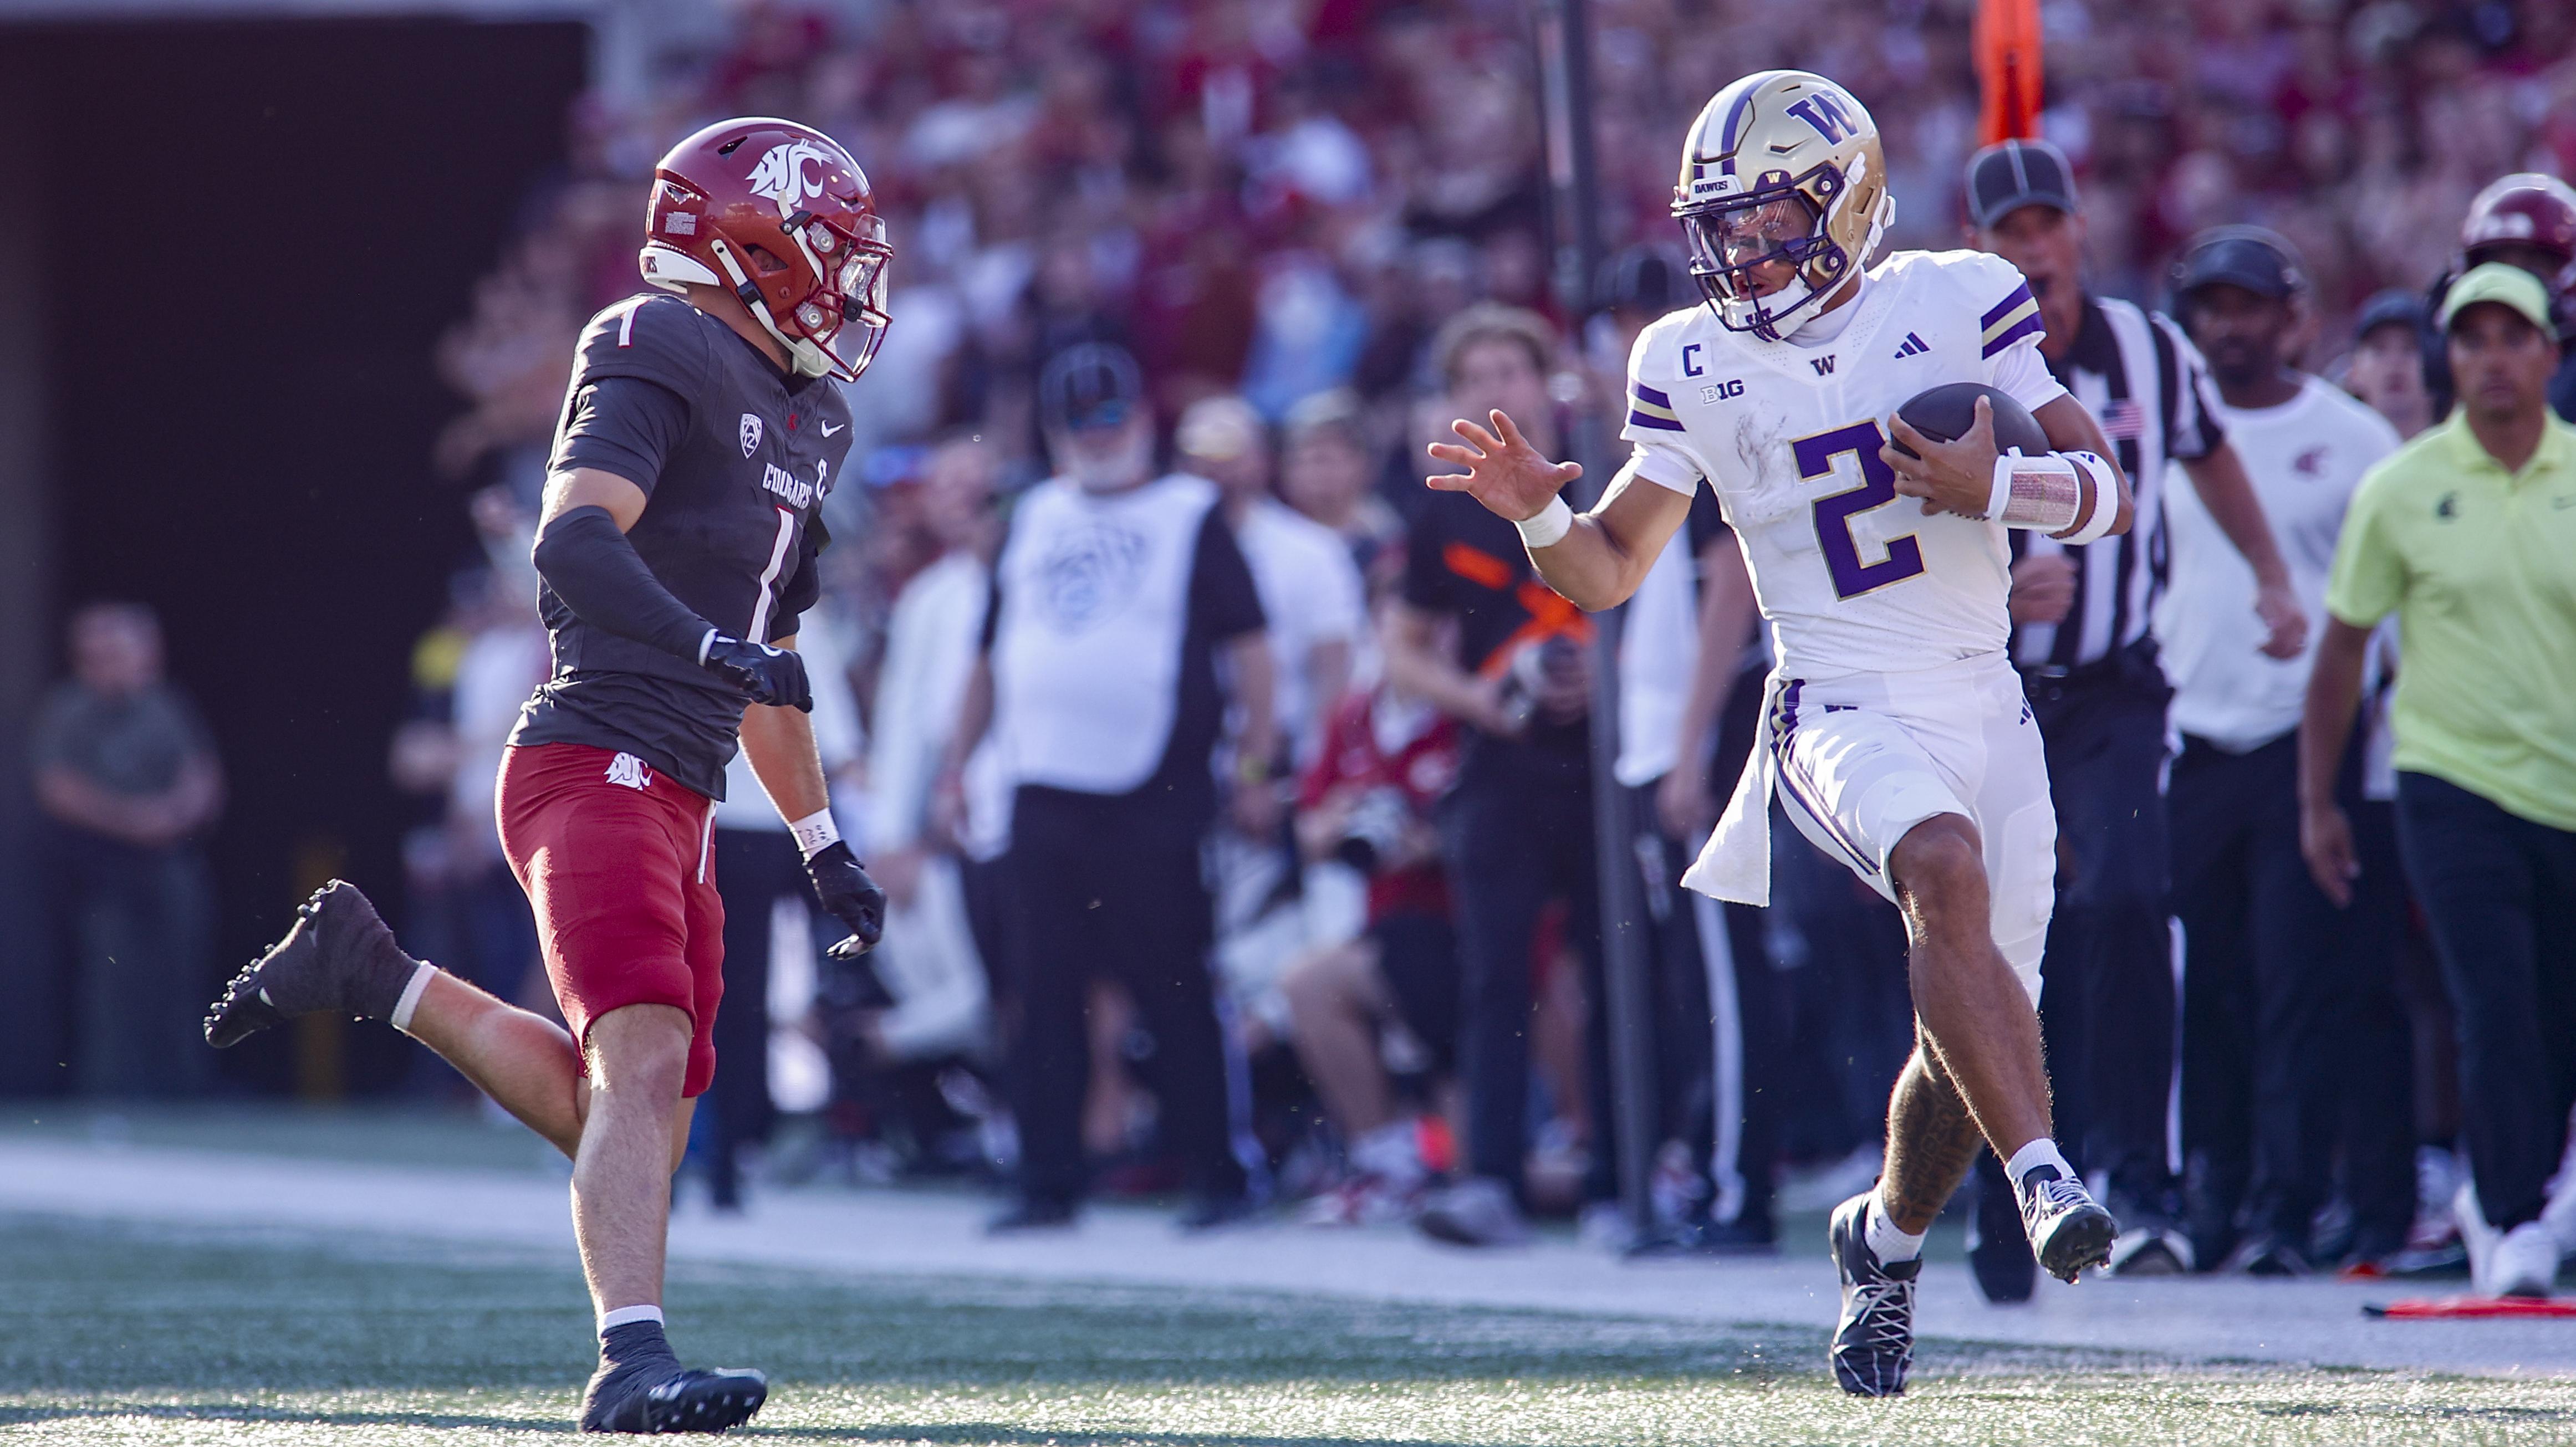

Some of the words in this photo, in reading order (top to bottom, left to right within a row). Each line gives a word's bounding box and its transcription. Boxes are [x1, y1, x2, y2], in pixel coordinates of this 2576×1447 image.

[1784, 89, 1859, 147] W
[1694, 180, 1728, 194] DAWGS
[1766, 172, 1781, 184] W
[1682, 343, 1703, 377] C
[1810, 354, 1837, 376] W
[744, 432, 756, 449] 12
[762, 462, 812, 510] COUGARS
[1788, 417, 1928, 602] 2
[746, 505, 794, 645] 1
